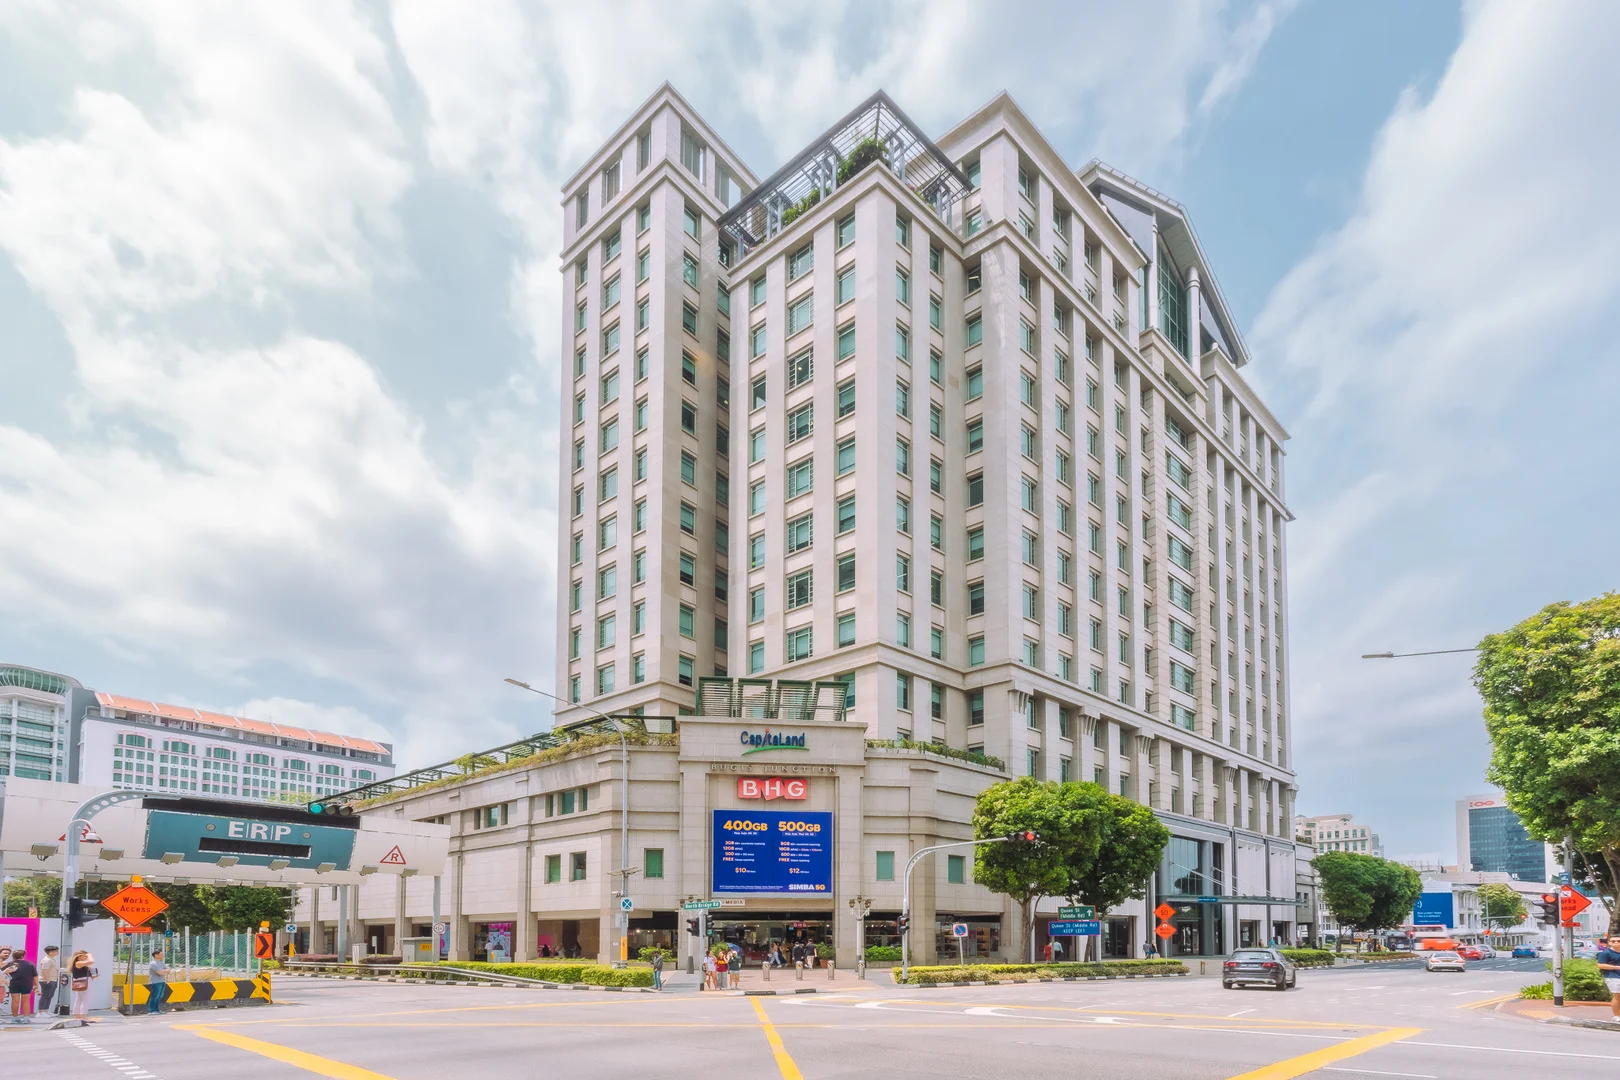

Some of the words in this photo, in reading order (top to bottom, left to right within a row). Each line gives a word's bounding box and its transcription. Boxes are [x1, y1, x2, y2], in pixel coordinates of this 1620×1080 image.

[740, 728, 805, 748] CapitaLand
[711, 763, 752, 772] BUGIS
[764, 765, 836, 773] JUNCTION
[742, 780, 804, 797] BHG
[228, 821, 292, 841] ERP
[723, 820, 768, 831] 400GB
[778, 821, 821, 832] 500GB
[390, 853, 398, 861] R
[122, 896, 149, 905] Works
[120, 905, 151, 913] Access
